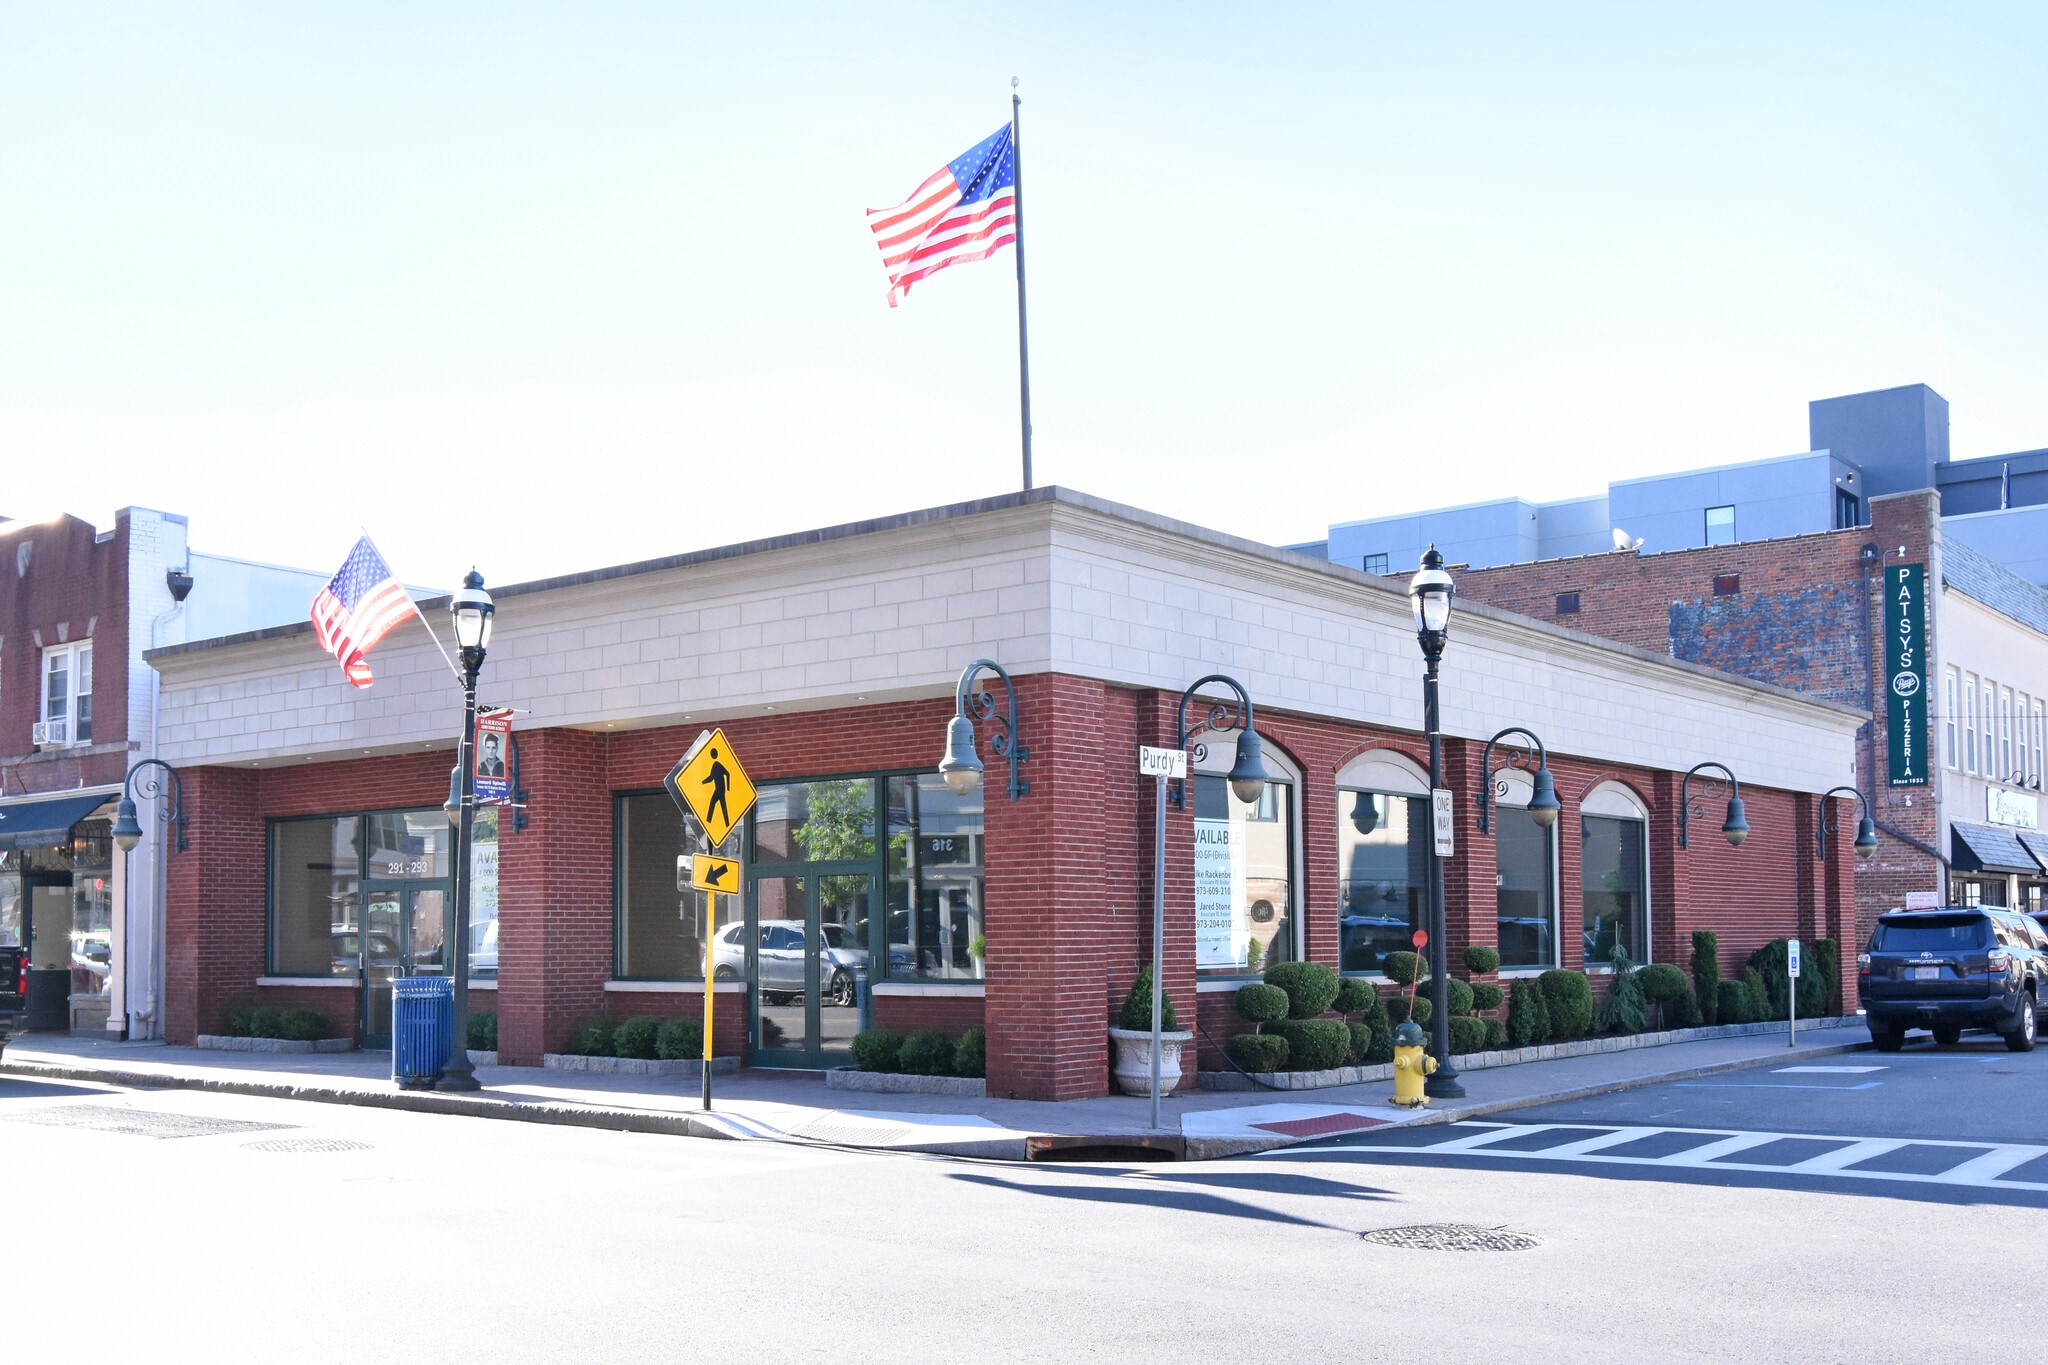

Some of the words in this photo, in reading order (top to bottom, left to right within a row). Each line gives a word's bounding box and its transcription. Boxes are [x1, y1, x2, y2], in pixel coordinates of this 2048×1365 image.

[1899, 568, 1913, 668] PATSY'S
[480, 718, 508, 727] HARRISON
[1903, 699, 1912, 776] PIZZERIA
[1143, 748, 1175, 775] Purdy
[1178, 752, 1185, 762] St
[1437, 796, 1449, 811] ONE
[1437, 816, 1450, 830] WAY
[1195, 829, 1240, 845] VAILABLE
[477, 852, 498, 864] AVA
[388, 863, 404, 874] 291
[411, 861, 428, 873] 293
[1205, 870, 1231, 878] Rackenbe
[1196, 887, 1231, 895] 973-609-210
[1200, 902, 1214, 910] Jared
[1215, 902, 1231, 910] Stone
[1196, 920, 1231, 929] 973-204-010
